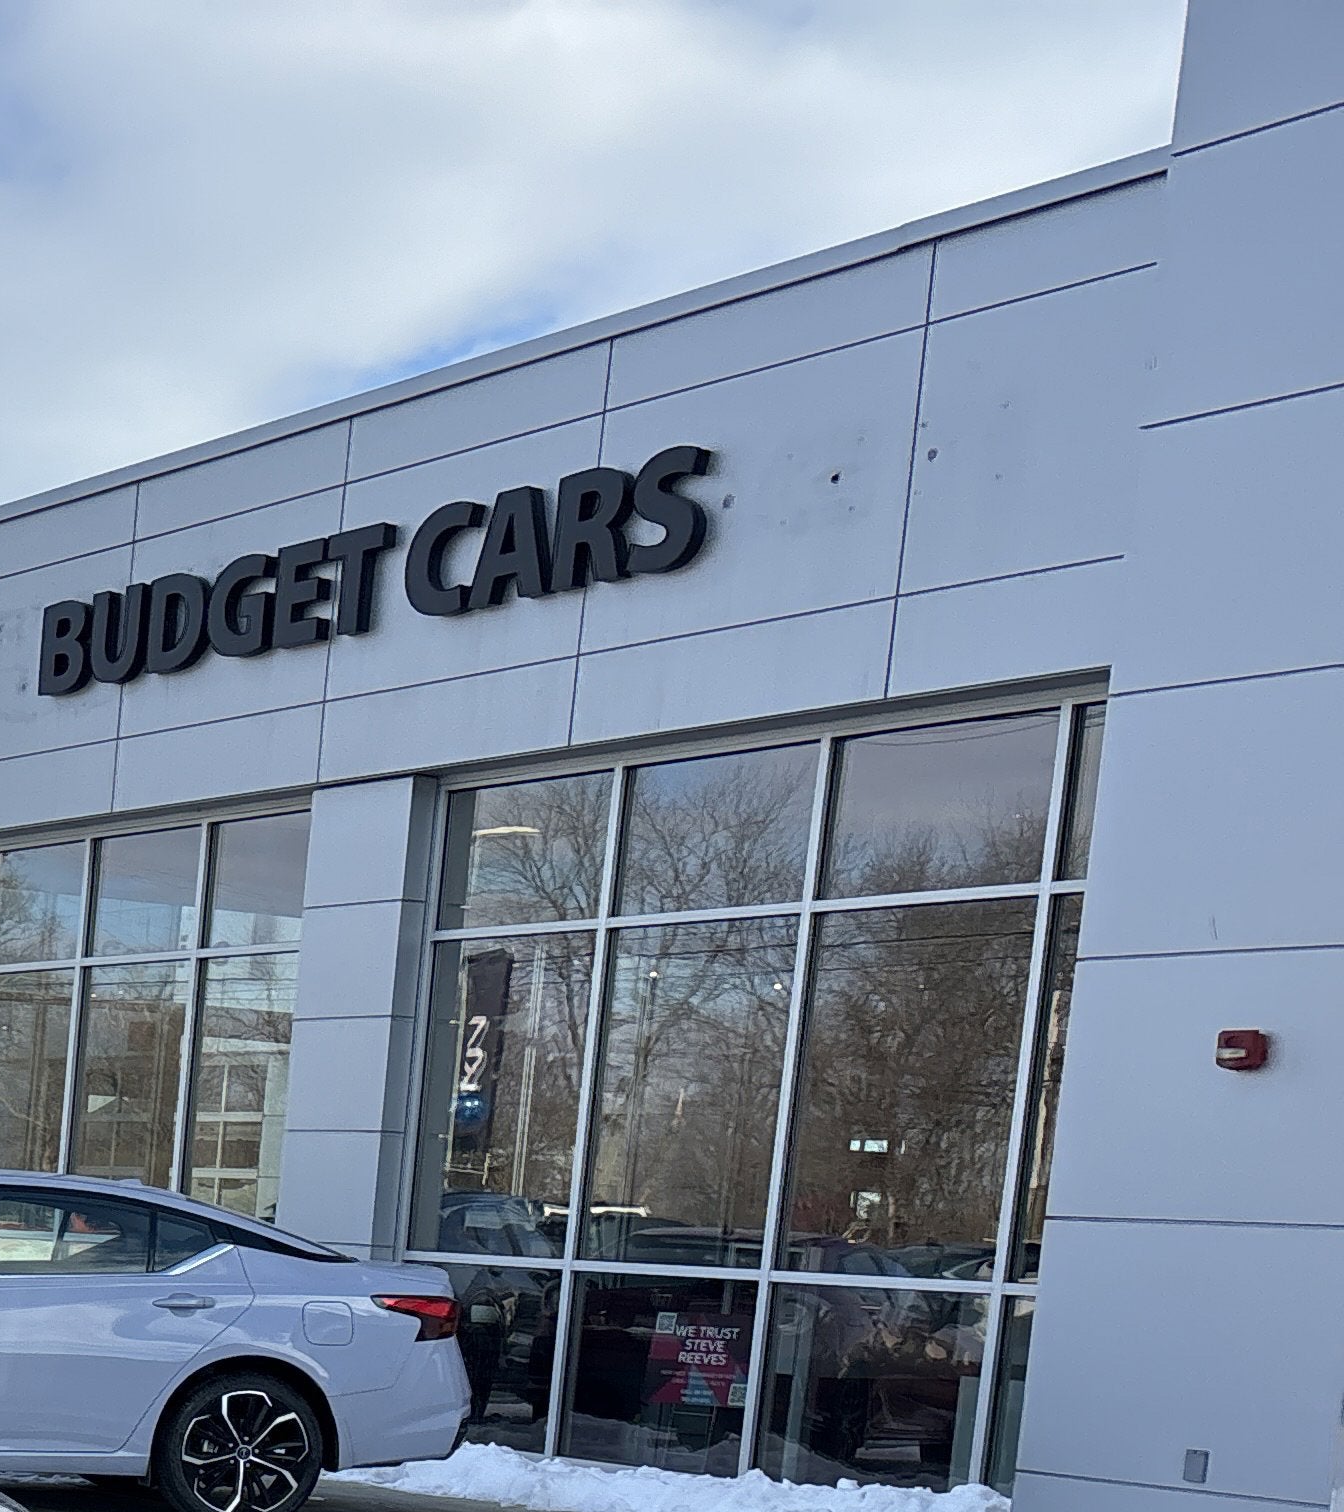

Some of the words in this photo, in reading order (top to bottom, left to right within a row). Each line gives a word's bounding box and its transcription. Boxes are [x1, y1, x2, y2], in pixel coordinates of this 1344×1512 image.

[39, 522, 399, 696] BUDGET
[405, 445, 713, 617] CARS
[675, 1325, 697, 1337] WE
[700, 1326, 740, 1339] TRUST
[684, 1339, 727, 1352] STEVE
[678, 1352, 728, 1365] REEVES
